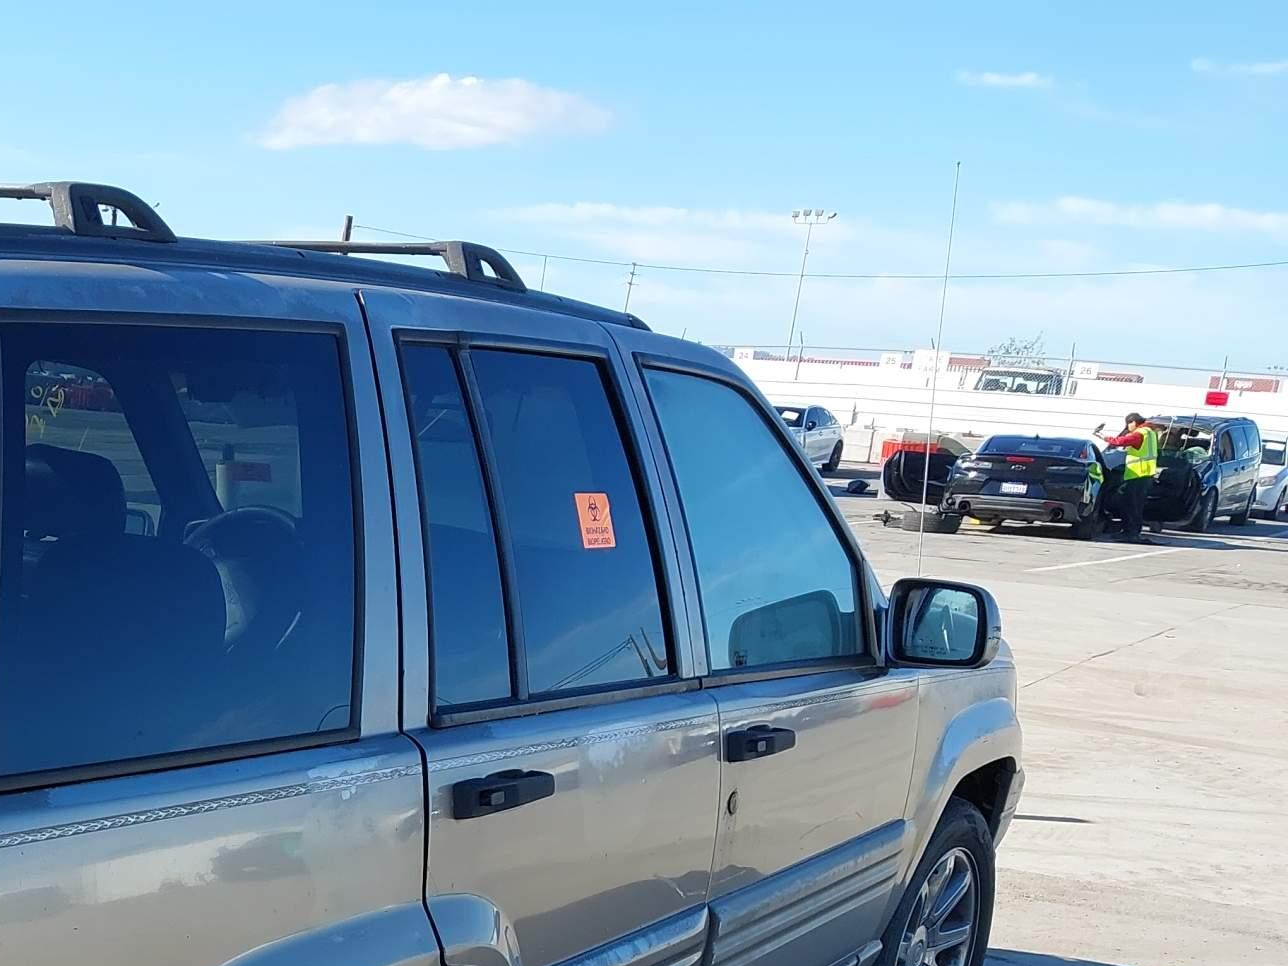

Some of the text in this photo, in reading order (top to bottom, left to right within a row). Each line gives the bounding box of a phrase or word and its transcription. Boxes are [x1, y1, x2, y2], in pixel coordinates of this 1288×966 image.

[738, 351, 749, 360] 24
[885, 356, 897, 365] 25
[1079, 366, 1093, 375] 26
